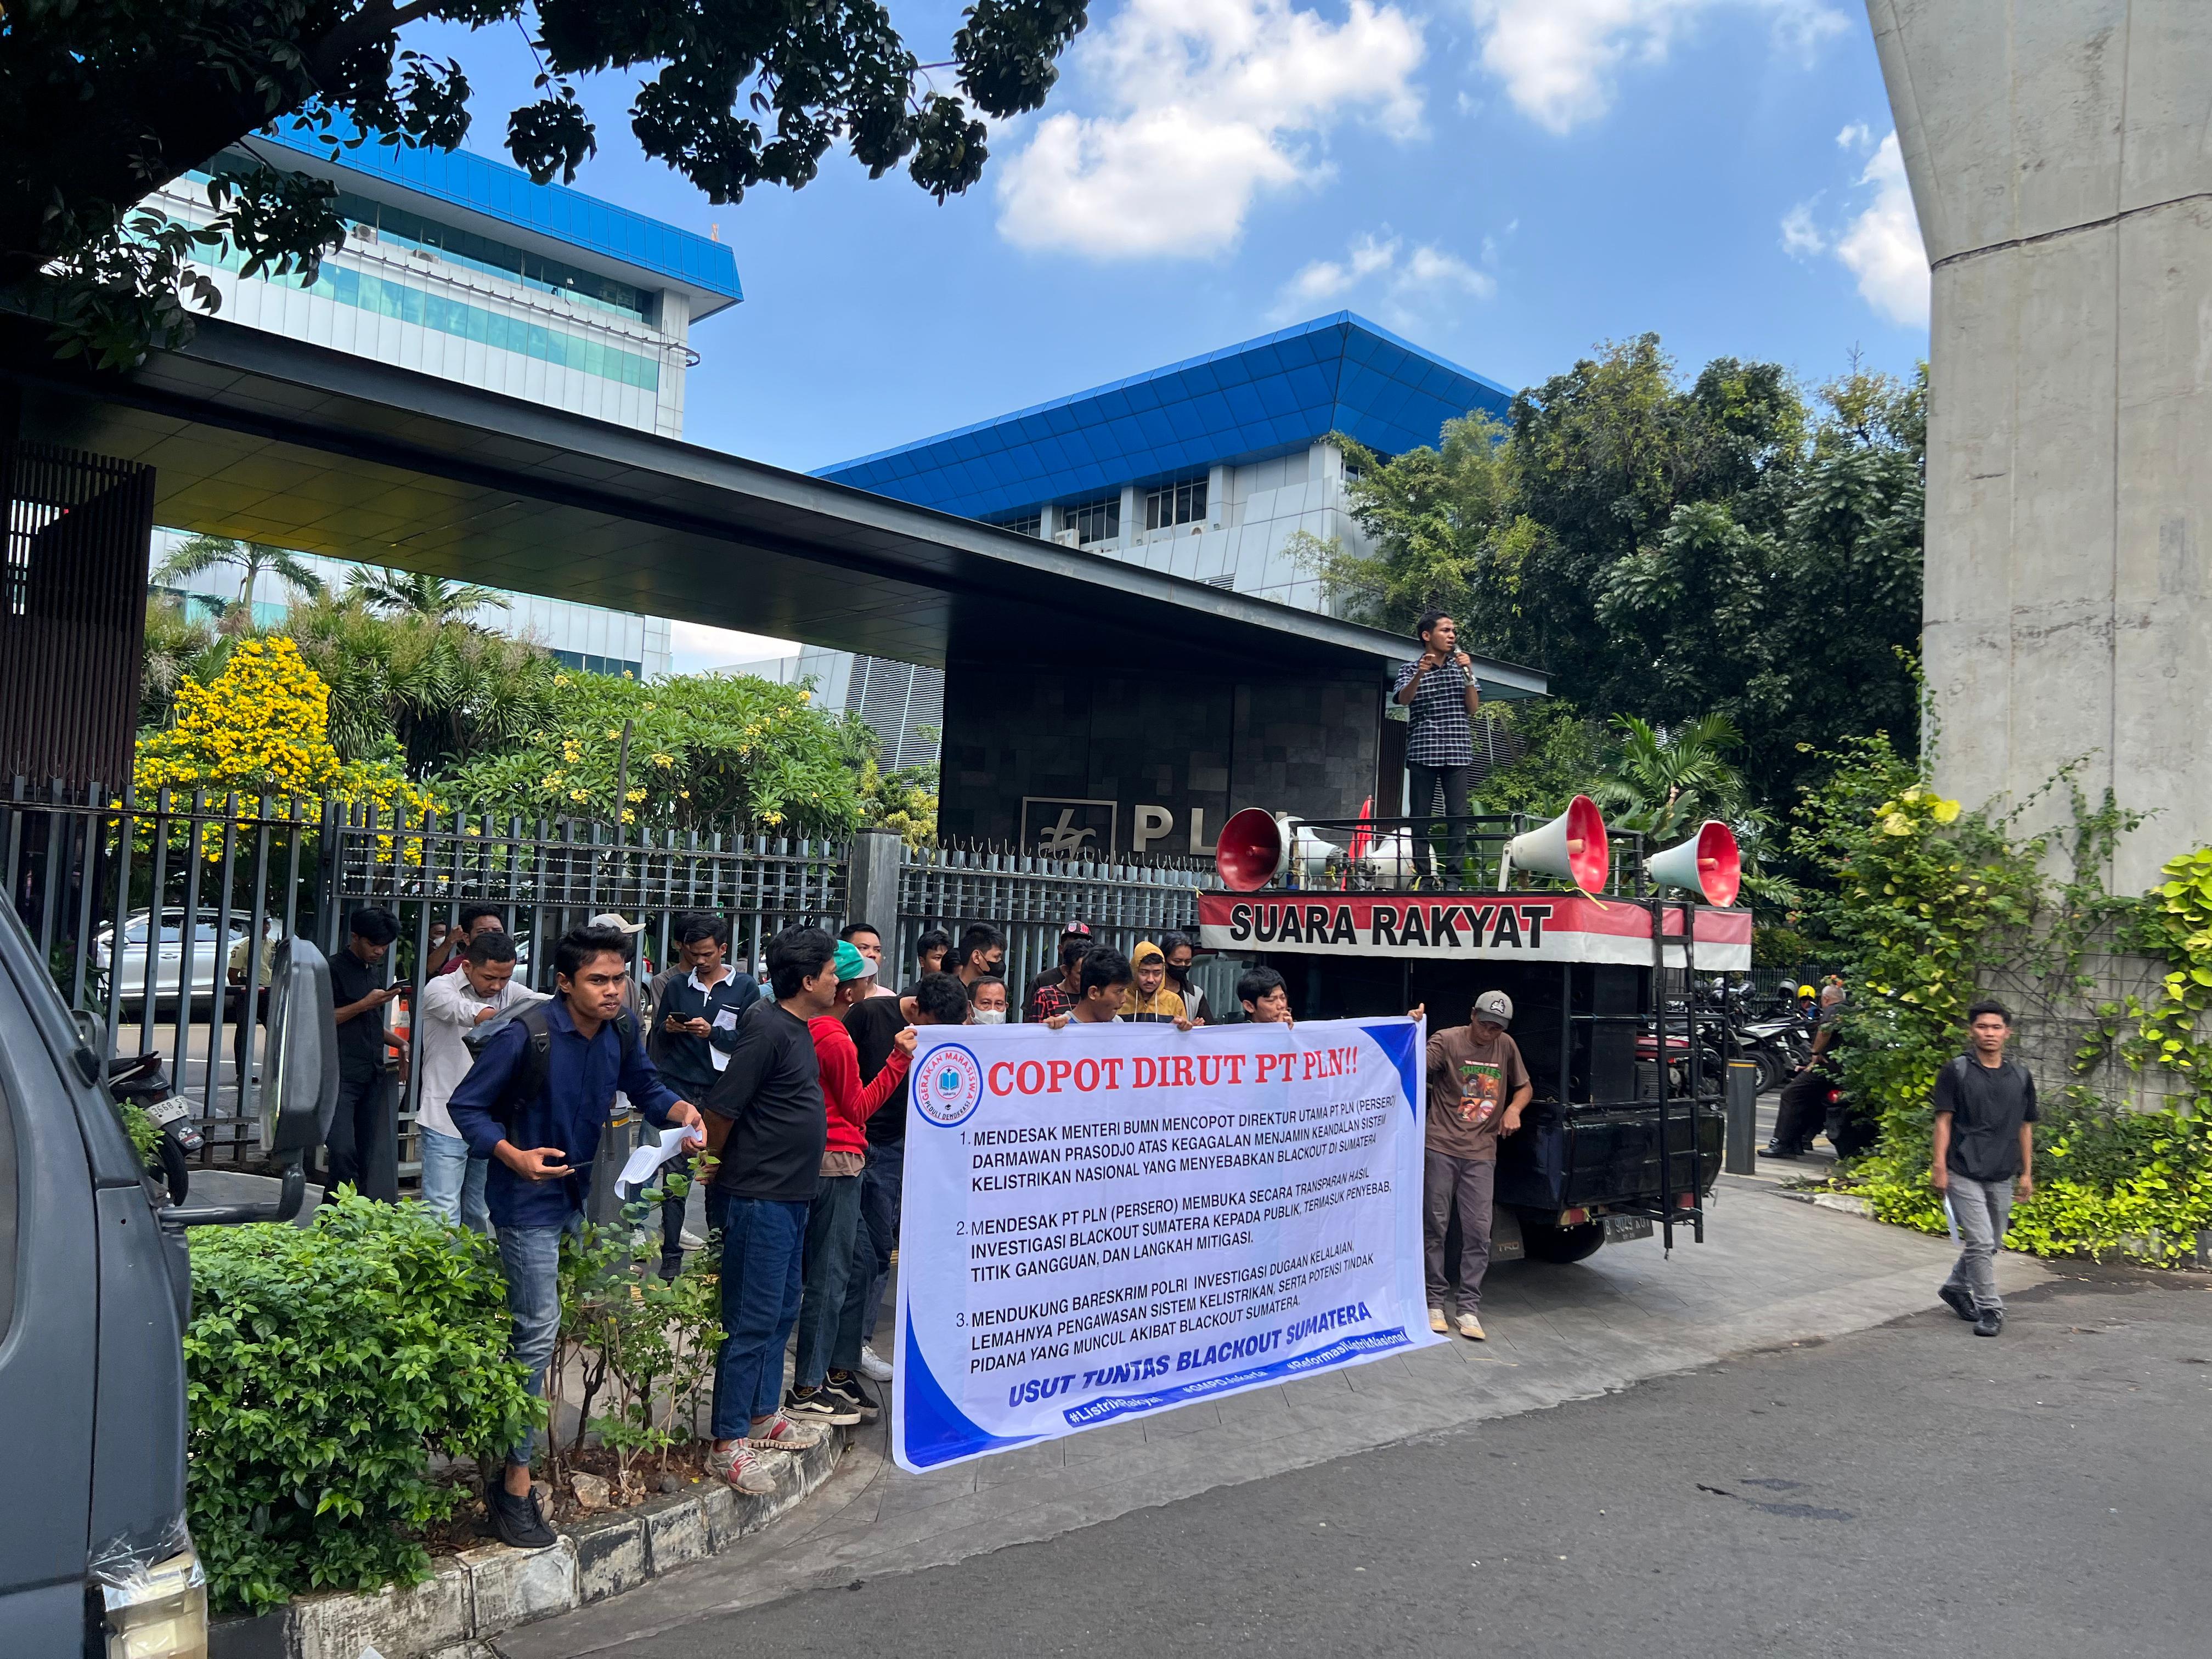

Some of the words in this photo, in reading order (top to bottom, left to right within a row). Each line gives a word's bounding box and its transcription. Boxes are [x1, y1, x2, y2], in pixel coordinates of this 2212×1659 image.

[1230, 903, 1357, 946] SUARA
[1372, 905, 1553, 949] RAKYAT
[921, 1054, 943, 1101] GERAKAN
[945, 1052, 975, 1099] MAHASISWA
[988, 1058, 1123, 1096] COPOT
[1132, 1054, 1246, 1088] DIRUT
[1255, 1053, 1297, 1084] PT
[1302, 1046, 1358, 1081] PLN!!
[925, 1101, 941, 1118] PEDULI
[942, 1101, 970, 1120] DEMOKRASI
[960, 1131, 970, 1145] 1.
[974, 1126, 1057, 1146] MENDESAK
[1062, 1122, 1120, 1139] MENTERI
[1124, 1119, 1159, 1135] BUMN
[1163, 1115, 1234, 1132] MENCOPOT
[1239, 1111, 1296, 1127] DIREKTUR
[1299, 1106, 1328, 1122] UTAMA
[1330, 1104, 1339, 1118] PT
[1341, 1102, 1354, 1116] PLN
[1356, 1094, 1396, 1115] (PERSERO)
[972, 1170, 1071, 1192] KELISTRIKAN
[1076, 1164, 1139, 1182] NASIONAL
[1143, 1159, 1176, 1175] YANG
[1180, 1151, 1274, 1171] MENYEBABKAN
[1277, 1144, 1327, 1163] BLACKOUT
[1329, 1141, 1336, 1154] DI
[1339, 1132, 1376, 1152] SUMATERA
[973, 1149, 1060, 1169] DARMAWAN
[1065, 1142, 1134, 1161] PRASODJO
[1138, 1139, 1167, 1154] ATAS
[1172, 1134, 1251, 1152] KEGAGALAN
[1255, 1128, 1310, 1146] MENJAMIN
[1312, 1119, 1359, 1138] KEANDALAN
[1361, 1114, 1386, 1129] SISTEM
[956, 1221, 968, 1235] 2.
[972, 1213, 1058, 1236] MENDESAK
[1062, 1211, 1079, 1226] PT
[1083, 1207, 1107, 1224] PLN
[1111, 1198, 1178, 1223] (PERSERO)
[1183, 1192, 1246, 1210] MEMBUKA
[1250, 1187, 1293, 1204] SECARA
[1296, 1172, 1347, 1195] TRANSPARAN
[1348, 1166, 1369, 1183] HASIL
[971, 1234, 1065, 1259] INVESTIGASI
[1070, 1224, 1139, 1247] BLACKOUT
[1142, 1216, 1210, 1237] SUMATERA
[1213, 1209, 1261, 1228] KEPADA
[1264, 1203, 1302, 1221] PUBLIK,
[1304, 1190, 1345, 1212] TERMASUK
[1346, 1180, 1392, 1200] PENYEBAB,
[956, 1312, 969, 1327] 3.
[972, 1299, 1068, 1327] MENDUKUNG
[1073, 1284, 1148, 1311] BARESKRIM
[1152, 1278, 1187, 1296] POLRI
[1194, 1266, 1267, 1289] INVESTIGASI
[1270, 1255, 1308, 1276] DUGAAN
[1310, 1240, 1355, 1262] KELALAIAN,
[971, 1263, 1011, 1282] TITIK
[1015, 1252, 1099, 1277] GANGGUAN,
[1103, 1248, 1130, 1263] DAN
[1133, 1238, 1193, 1259] LANGKAH
[1197, 1231, 1253, 1250] MITIGASI.
[972, 1324, 1053, 1351] LEMAHNYA
[1057, 1305, 1147, 1336] PENGAWASAN
[1150, 1298, 1196, 1317] SISTEM
[1200, 1283, 1276, 1308] KELISTRIKAN,
[1278, 1274, 1306, 1293] SERTA
[1309, 1262, 1342, 1284] POTENSI
[1344, 1252, 1374, 1271] TINDAK
[970, 1351, 1026, 1373] PIDANA
[1030, 1342, 1069, 1361] YANG
[1074, 1331, 1126, 1355] MUNCUL
[1130, 1322, 1177, 1342] AKIBAT
[1180, 1309, 1244, 1333] BLACKOUT
[1246, 1295, 1300, 1319] SUMATERA.
[1009, 1374, 1076, 1408] USUT
[1082, 1355, 1170, 1389] TUNTAS
[1177, 1329, 1283, 1371] BLACKOUT
[1286, 1301, 1372, 1345] SUMATERA
[1069, 1396, 1164, 1423] #ListrikRakyat
